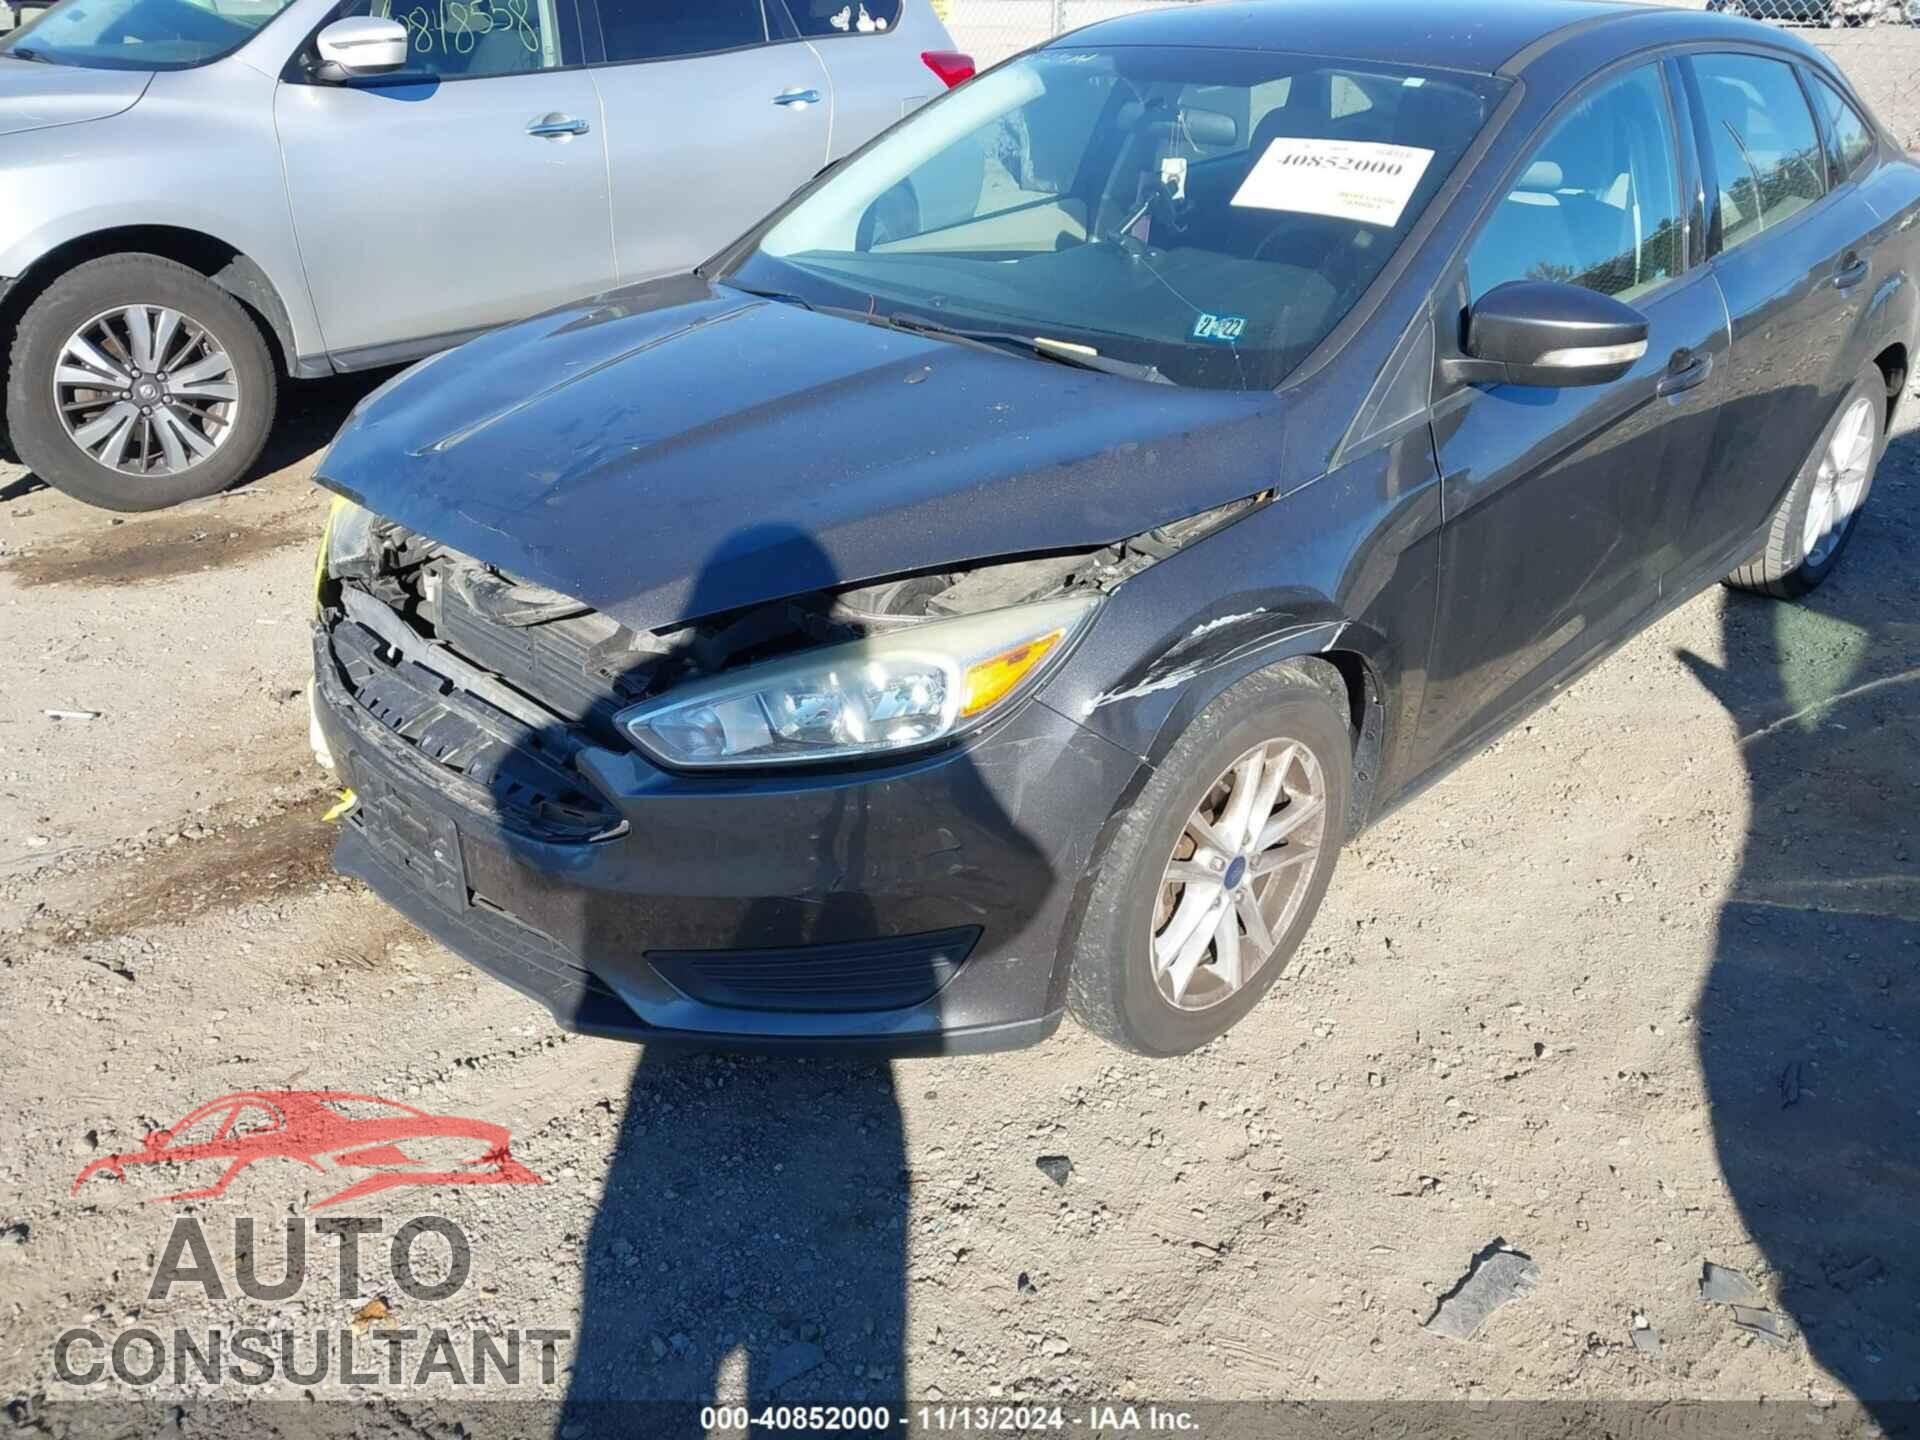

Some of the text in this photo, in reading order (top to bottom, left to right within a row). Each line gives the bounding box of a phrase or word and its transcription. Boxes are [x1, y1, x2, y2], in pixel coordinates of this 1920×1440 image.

[382, 0, 539, 54] 848558
[1277, 153, 1404, 176] 40852000
[1199, 316, 1212, 335] 2
